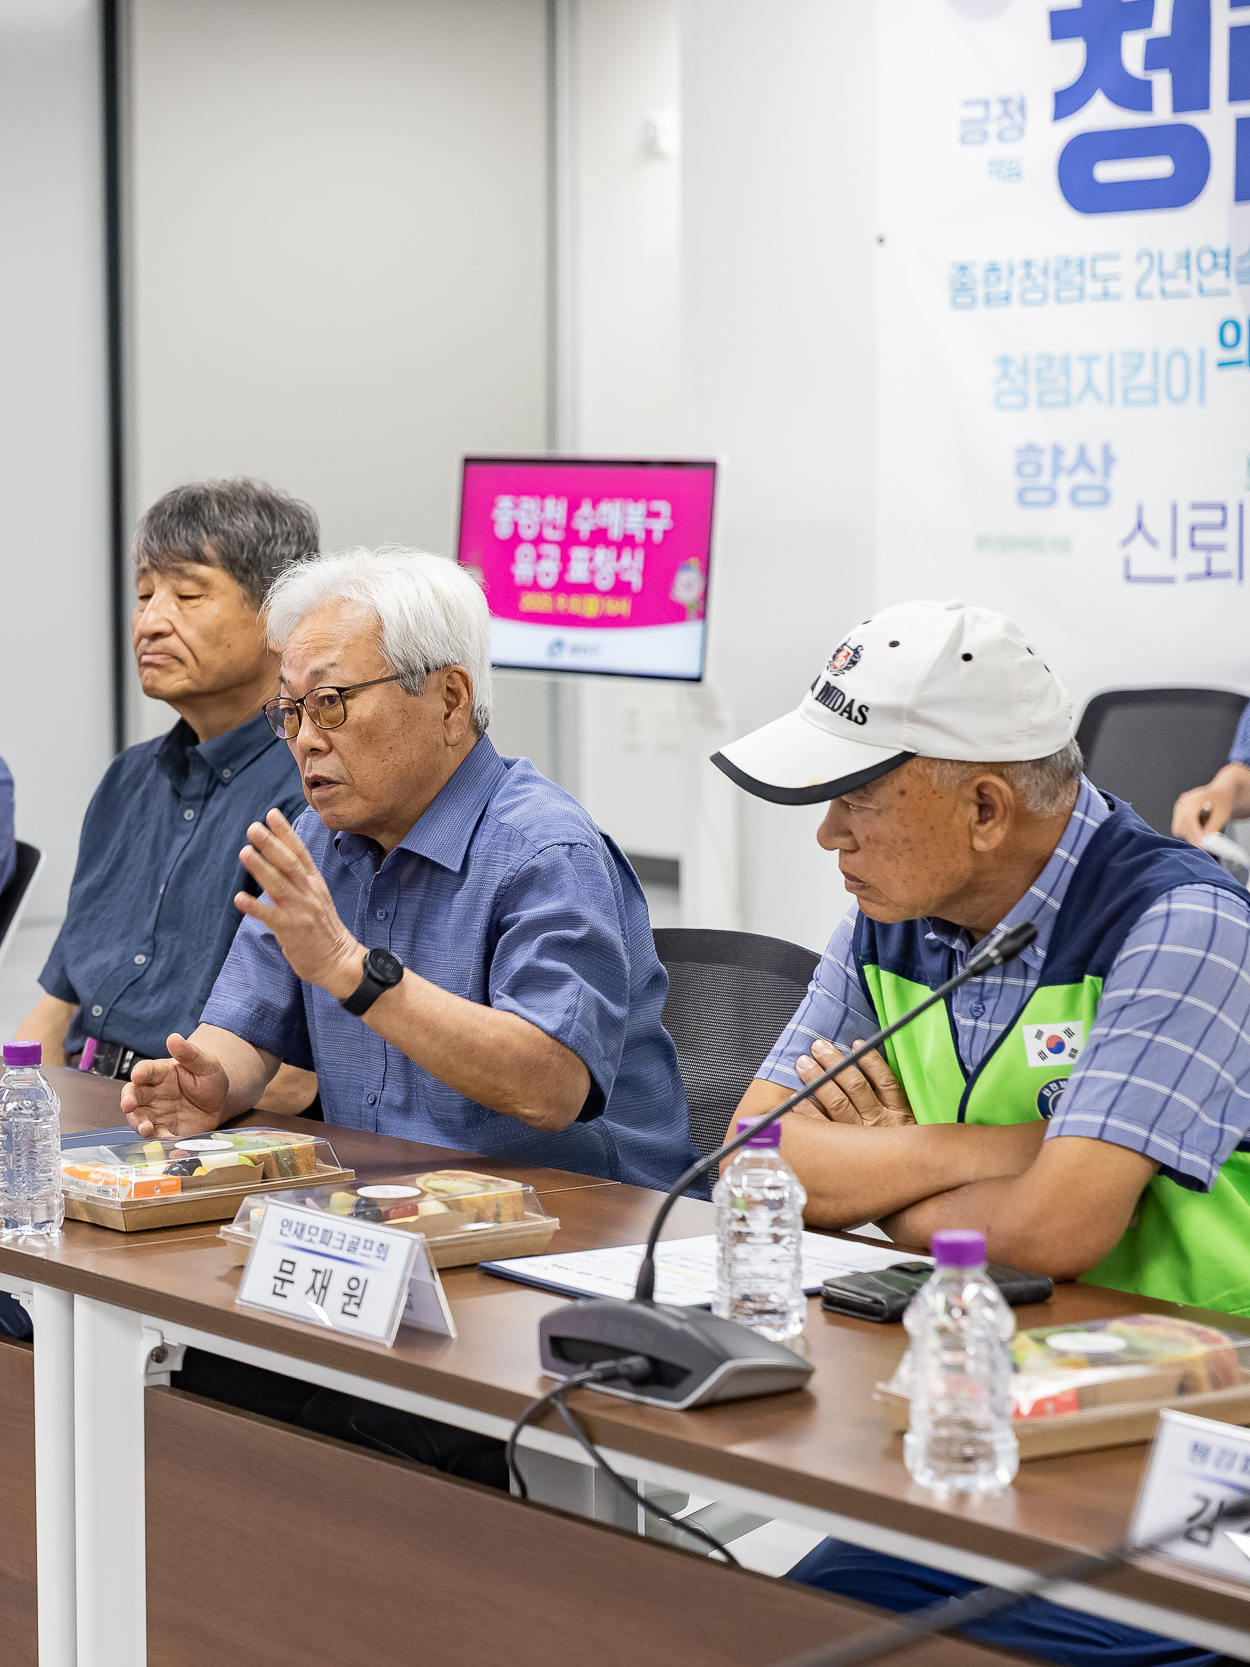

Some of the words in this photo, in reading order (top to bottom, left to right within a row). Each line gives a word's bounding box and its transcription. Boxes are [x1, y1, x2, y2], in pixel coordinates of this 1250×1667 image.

[1049, 0, 1250, 216] 청
[949, 252, 1123, 310] 종합청렴도
[993, 346, 1207, 411] 청렴지킴이
[1015, 442, 1116, 507] 향상
[1119, 500, 1244, 584] 신뢰
[815, 681, 869, 726] MIDAS
